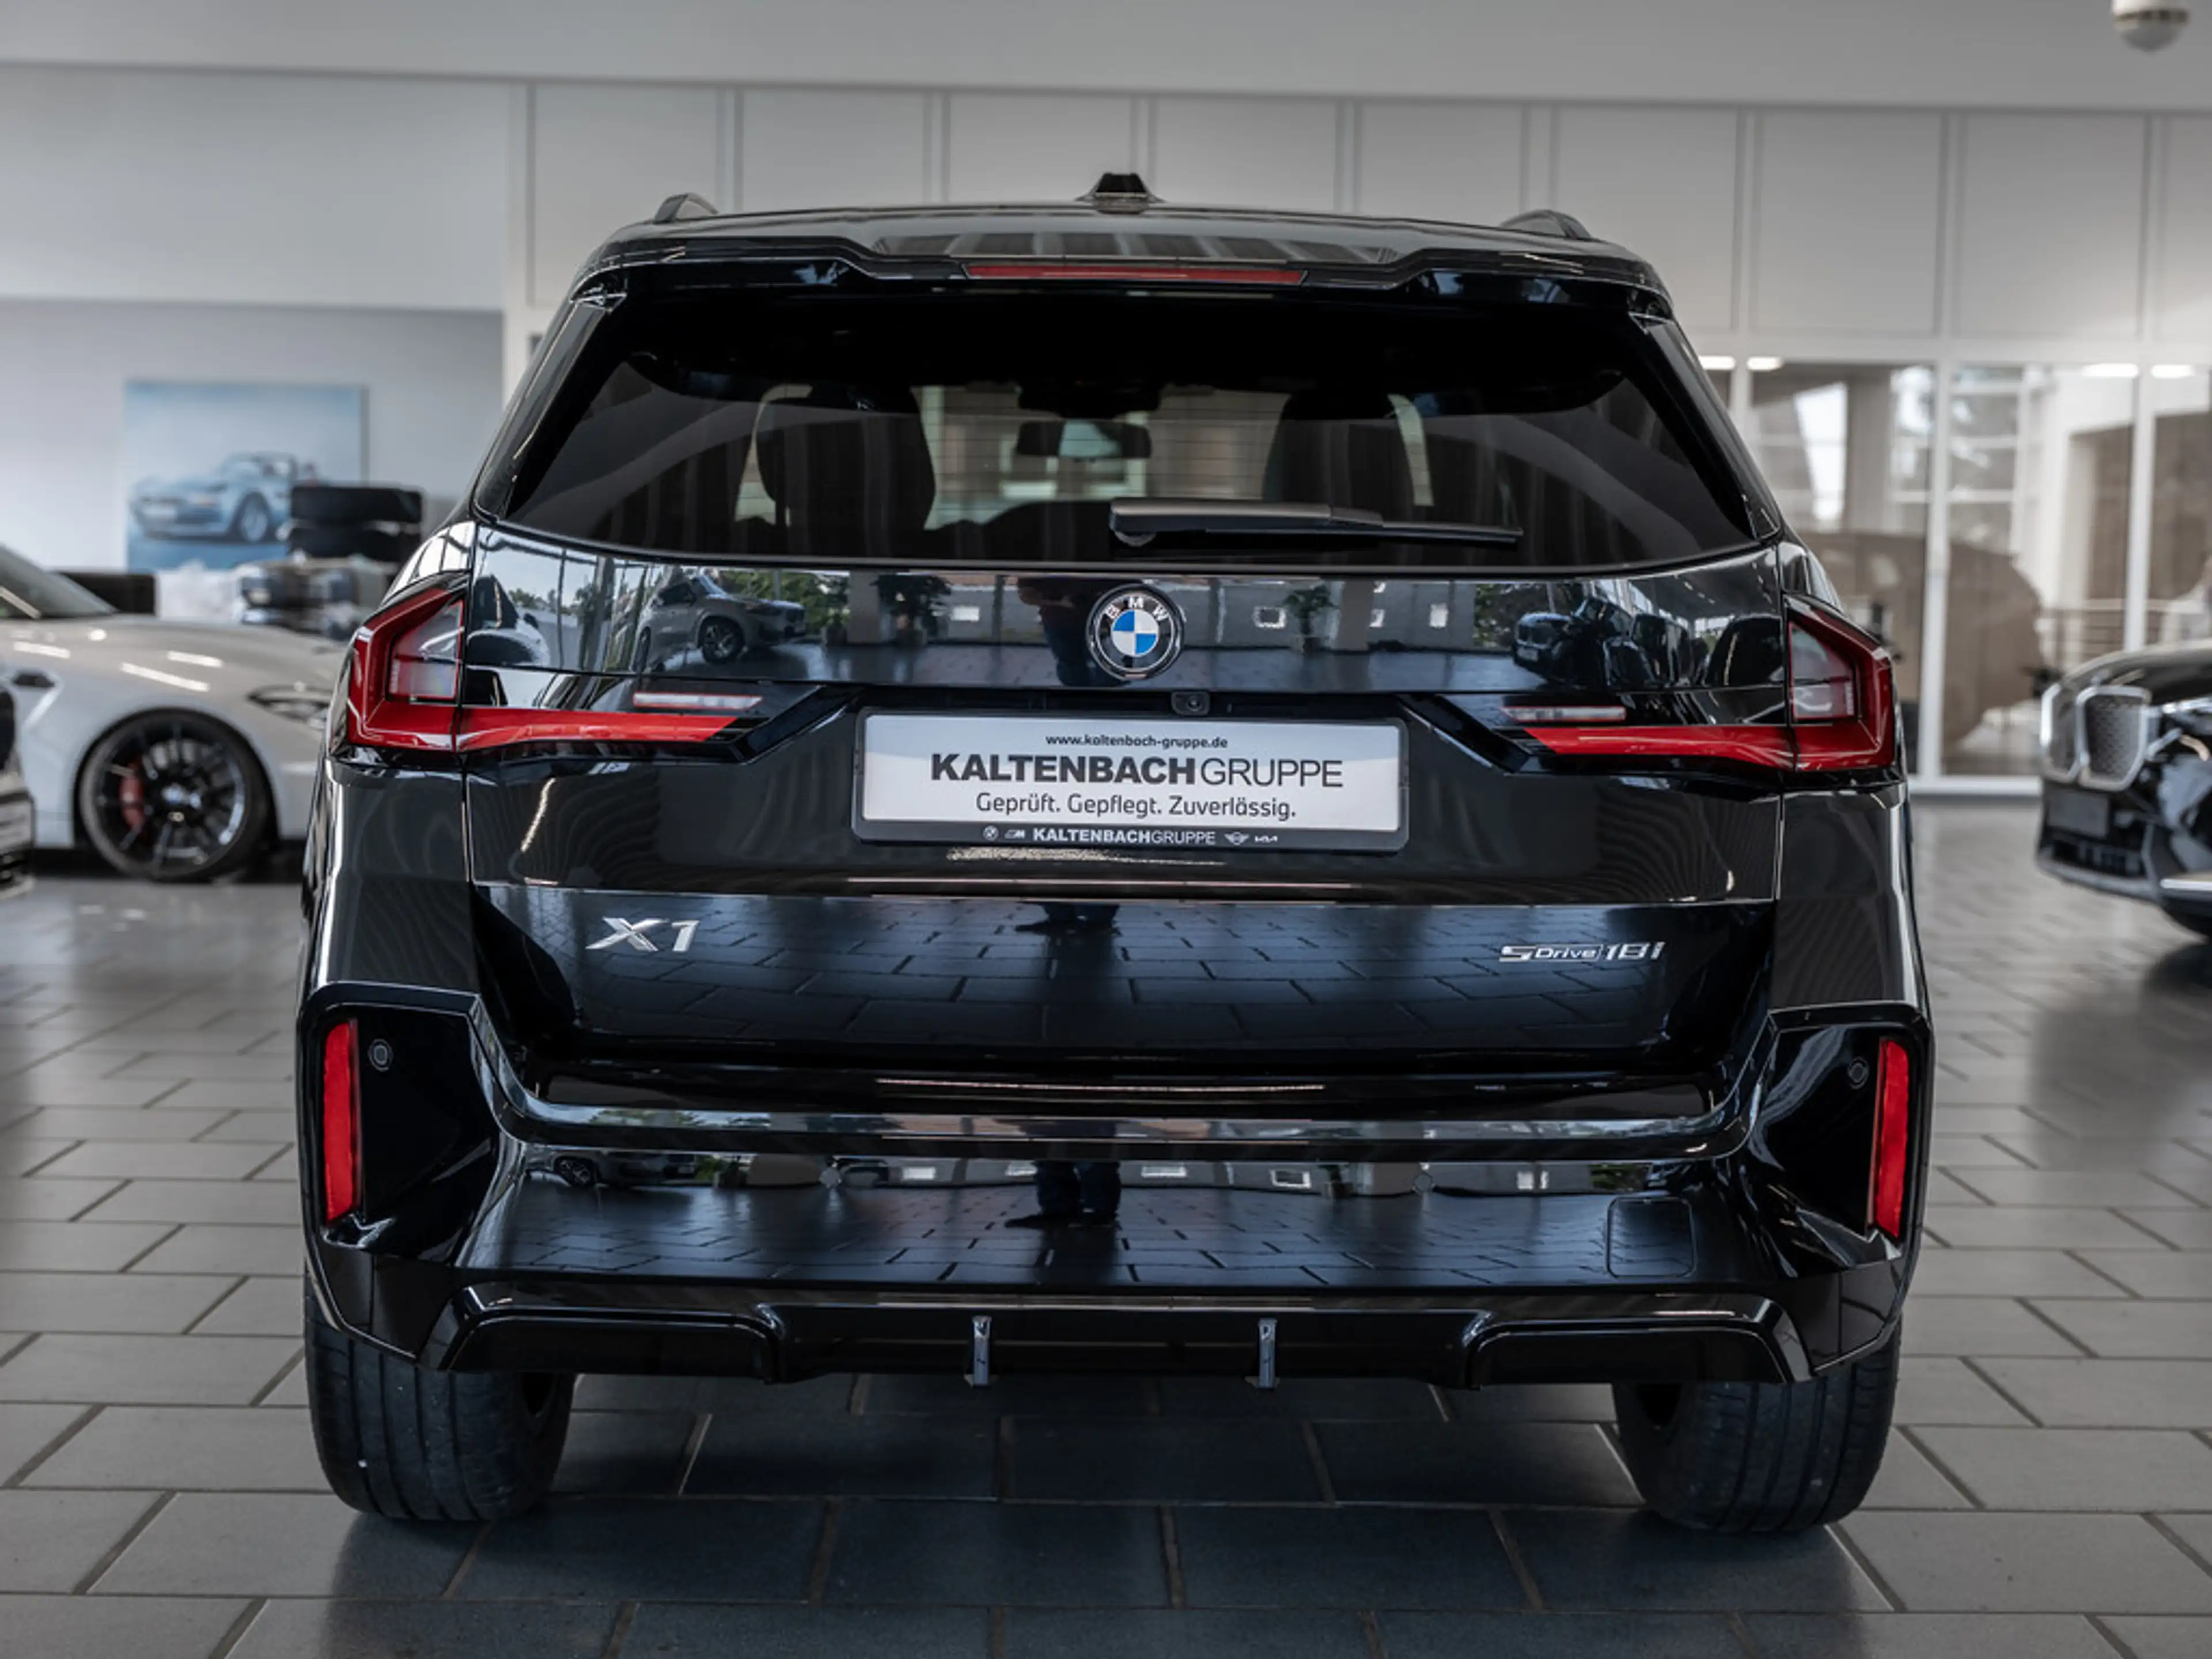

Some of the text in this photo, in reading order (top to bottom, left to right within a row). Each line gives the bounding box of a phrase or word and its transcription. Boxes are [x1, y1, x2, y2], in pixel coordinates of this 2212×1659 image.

[1105, 596, 1169, 621] BMW
[1046, 734, 1228, 748] www.kaltenbach-gruppe.de
[931, 753, 1343, 787] KALTENBACHGRUPPE
[976, 792, 1296, 821] Geprüft. Gepflegt. Zuverlässig.
[1033, 828, 1216, 845] KALTENBACHGRUPPE
[585, 916, 700, 952] X1
